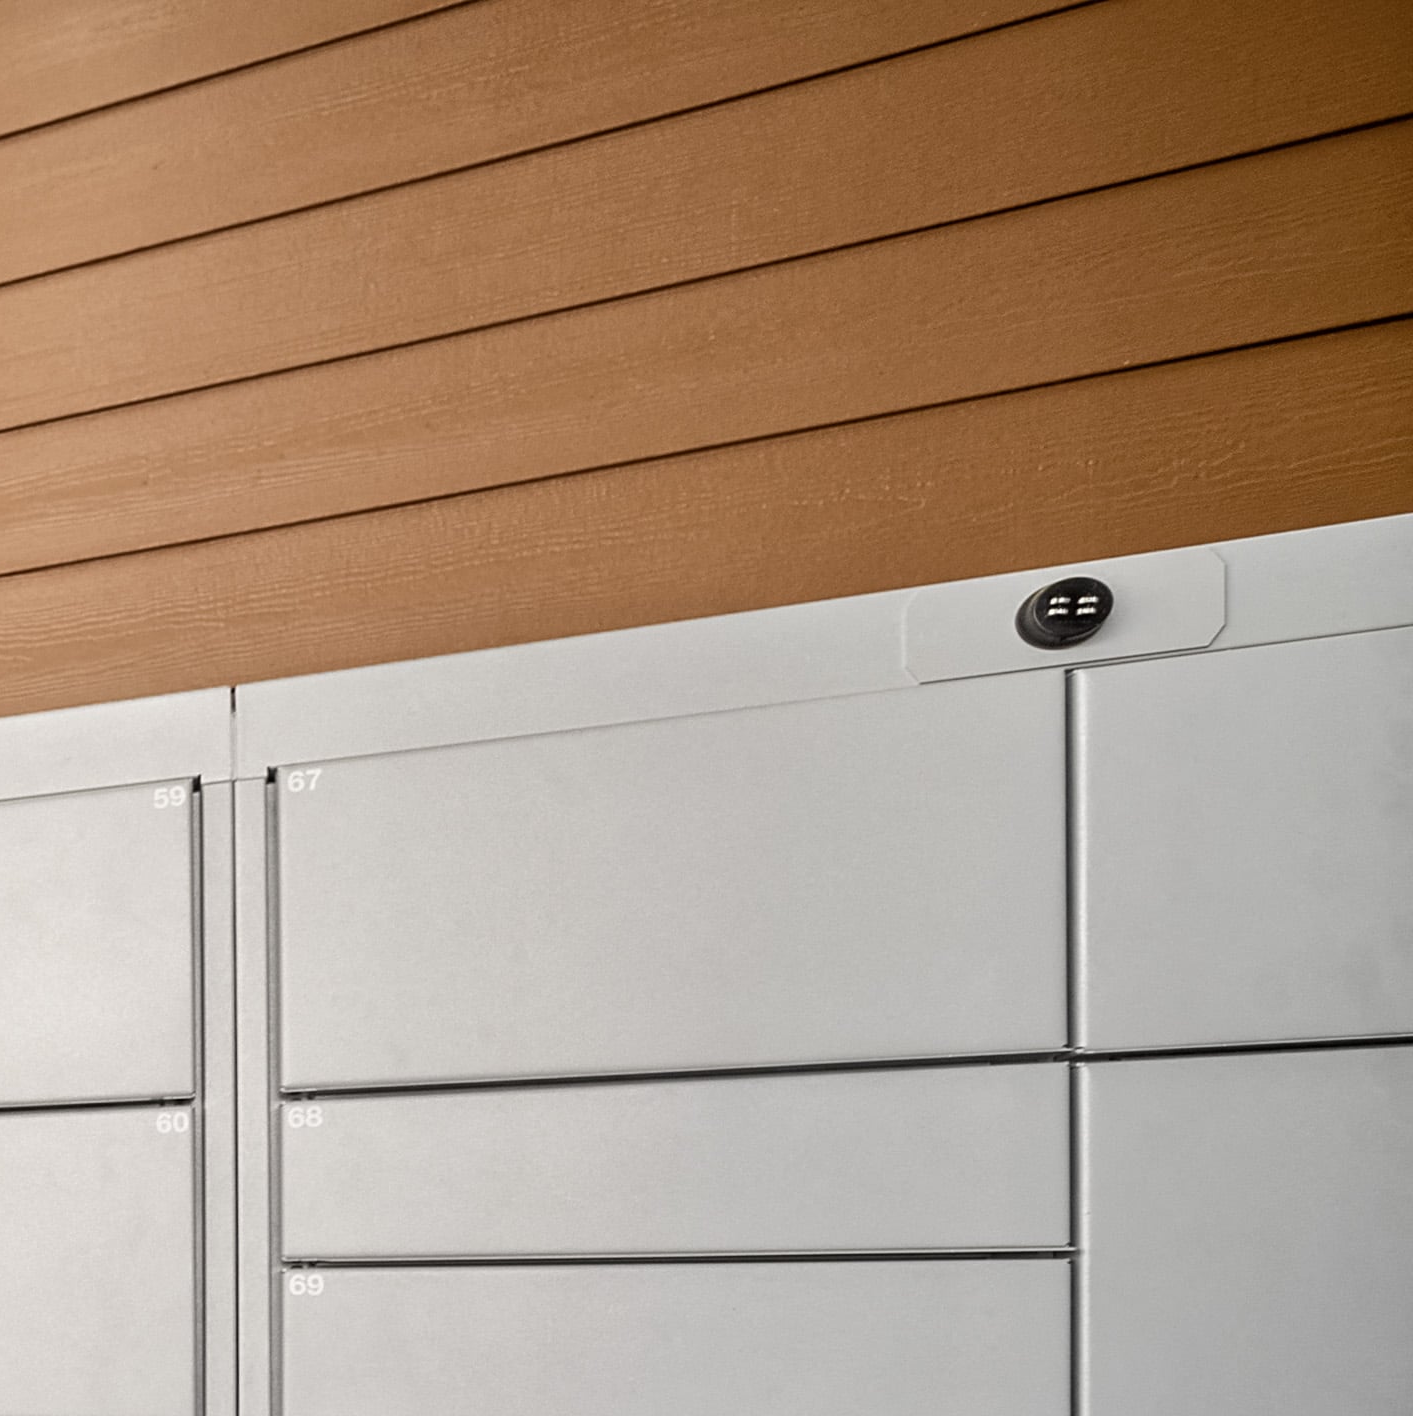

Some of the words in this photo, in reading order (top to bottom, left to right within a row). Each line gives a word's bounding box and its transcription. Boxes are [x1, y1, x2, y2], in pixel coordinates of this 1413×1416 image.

[287, 768, 322, 792] 67
[153, 785, 186, 809] 59
[156, 1111, 189, 1133] 60
[288, 1105, 323, 1128] 68
[289, 1273, 324, 1296] 69
